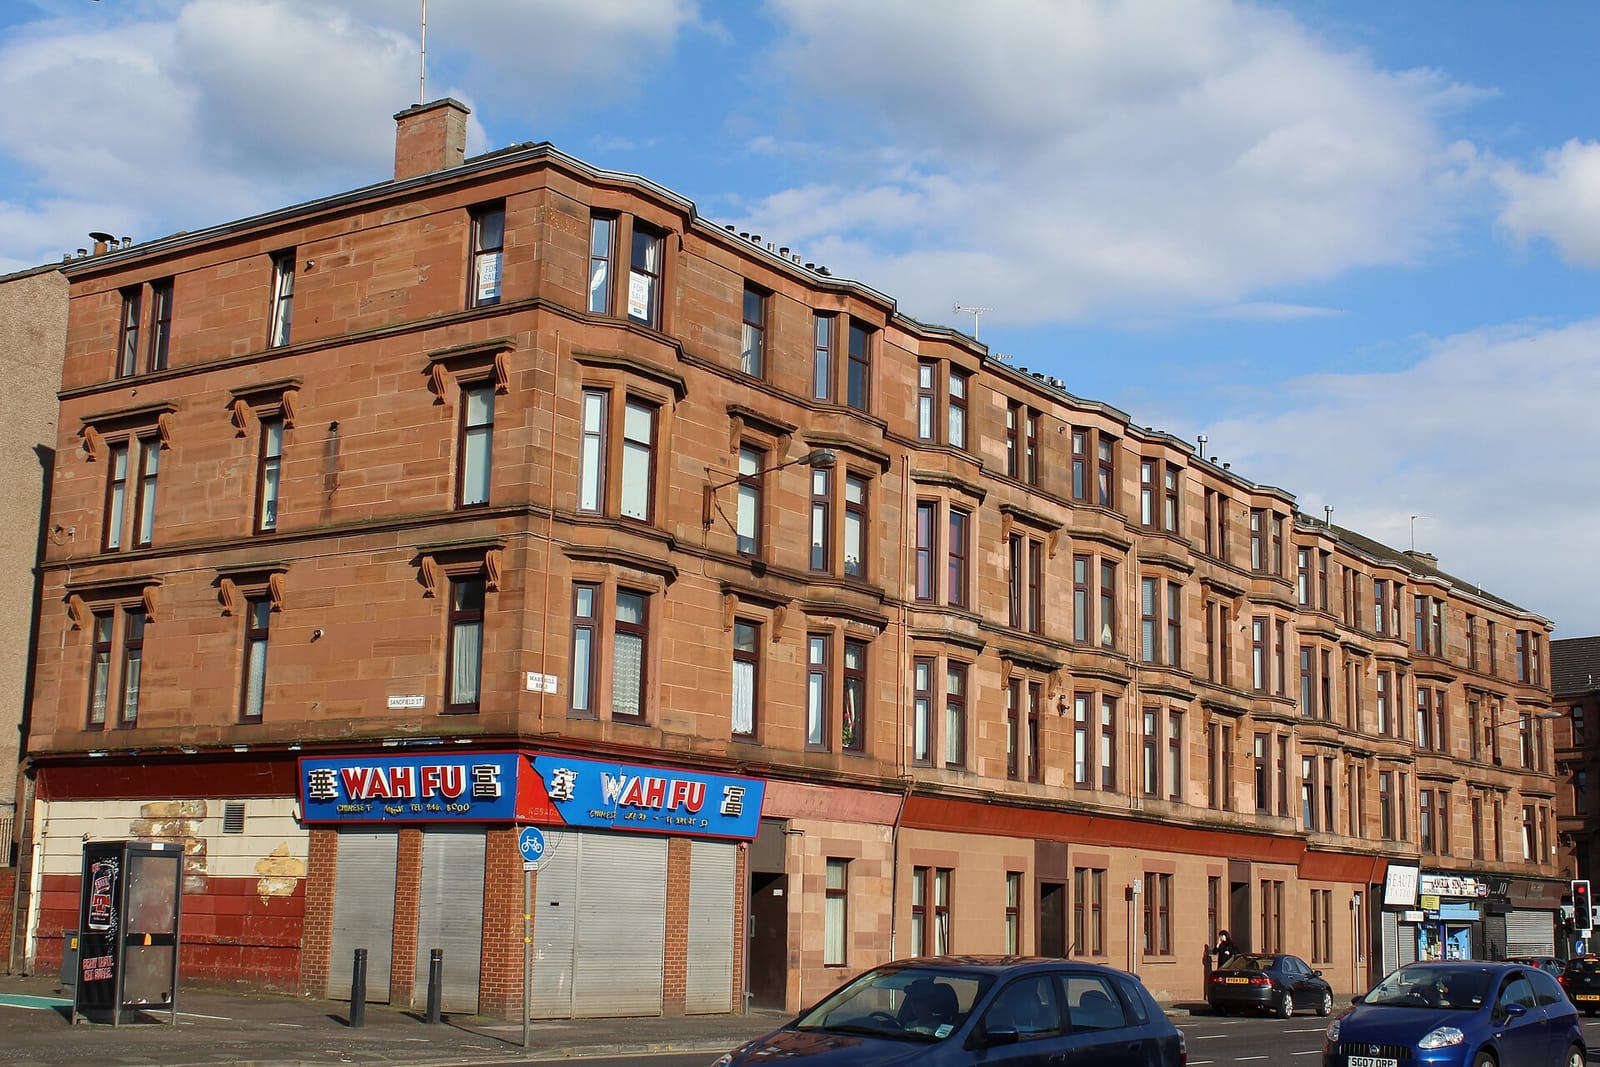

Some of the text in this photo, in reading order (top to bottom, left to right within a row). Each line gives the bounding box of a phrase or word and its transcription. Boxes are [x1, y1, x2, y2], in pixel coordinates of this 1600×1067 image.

[485, 264, 498, 274] FOR
[483, 272, 499, 283] SALE
[632, 282, 645, 293] FOR
[631, 291, 647, 302] SALE
[390, 698, 415, 706] SANDFIELD
[341, 765, 467, 800] WAH FU
[599, 771, 707, 812] WAH FU
[1388, 871, 1416, 888] BEAUTY
[1352, 1057, 1374, 1067] SG07
